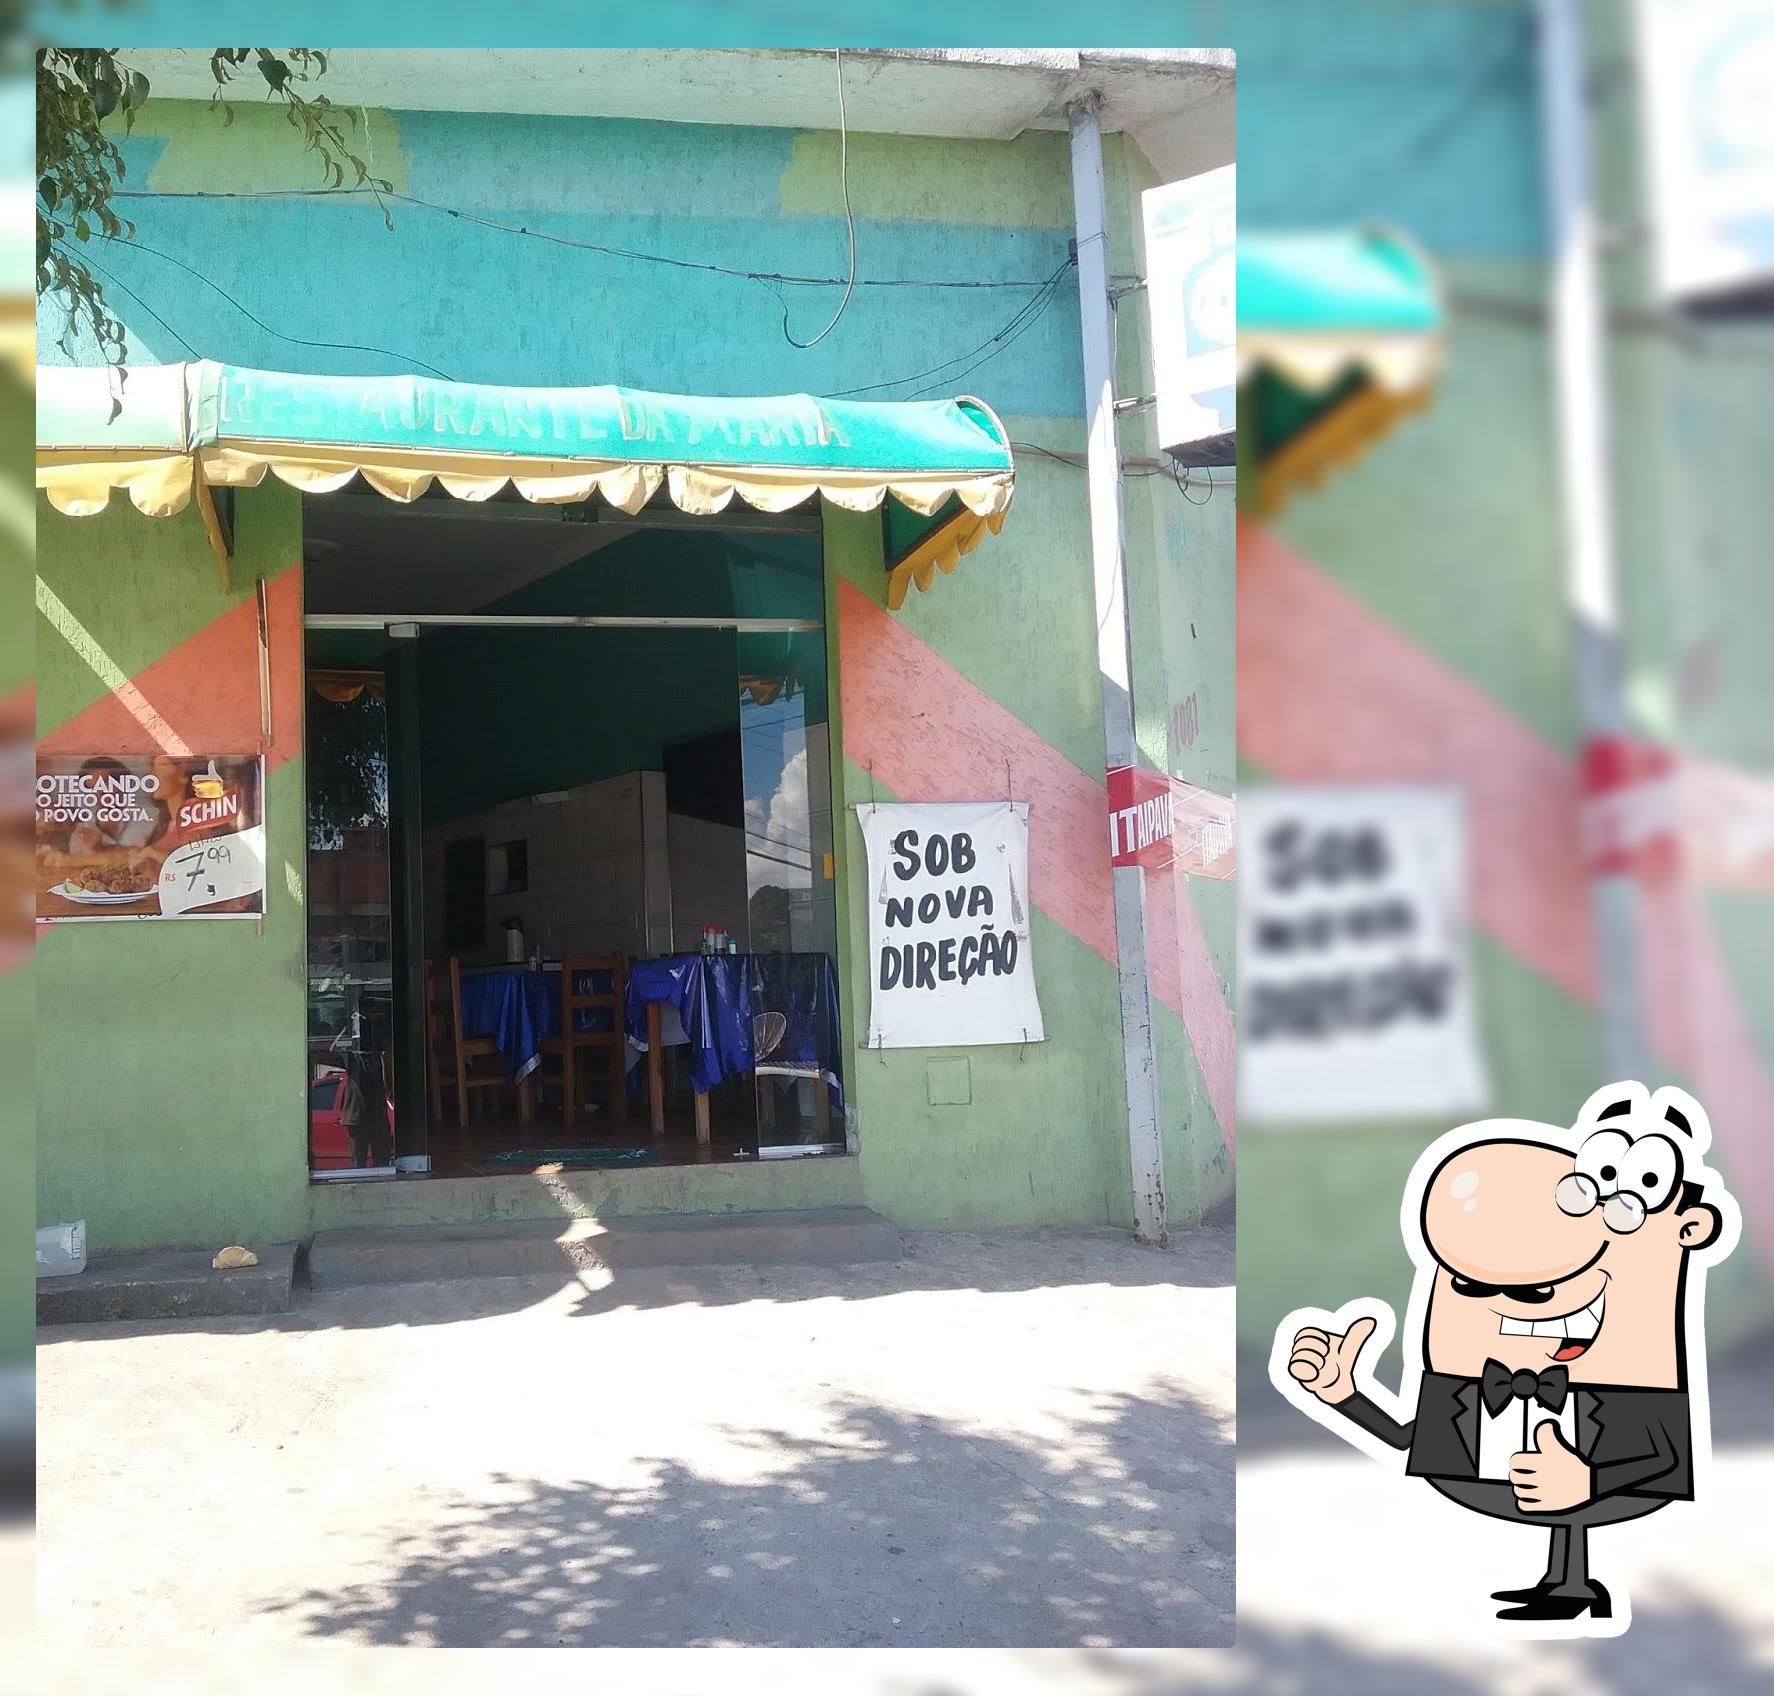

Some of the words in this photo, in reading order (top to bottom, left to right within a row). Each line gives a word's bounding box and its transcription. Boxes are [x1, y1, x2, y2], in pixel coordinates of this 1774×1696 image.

[220, 376, 608, 440] RESTAURANTE
[618, 394, 676, 443] DA
[43, 808, 93, 823] POVO
[96, 808, 154, 823] GOSTA.
[52, 793, 98, 809] JEITO
[100, 793, 137, 809] QUE
[179, 793, 238, 828] SCHIN
[1109, 791, 1175, 858] ITAIPAVA
[893, 829, 977, 881] SOB
[885, 885, 994, 928] NOVA
[879, 923, 1018, 991] DIREÇÃO
